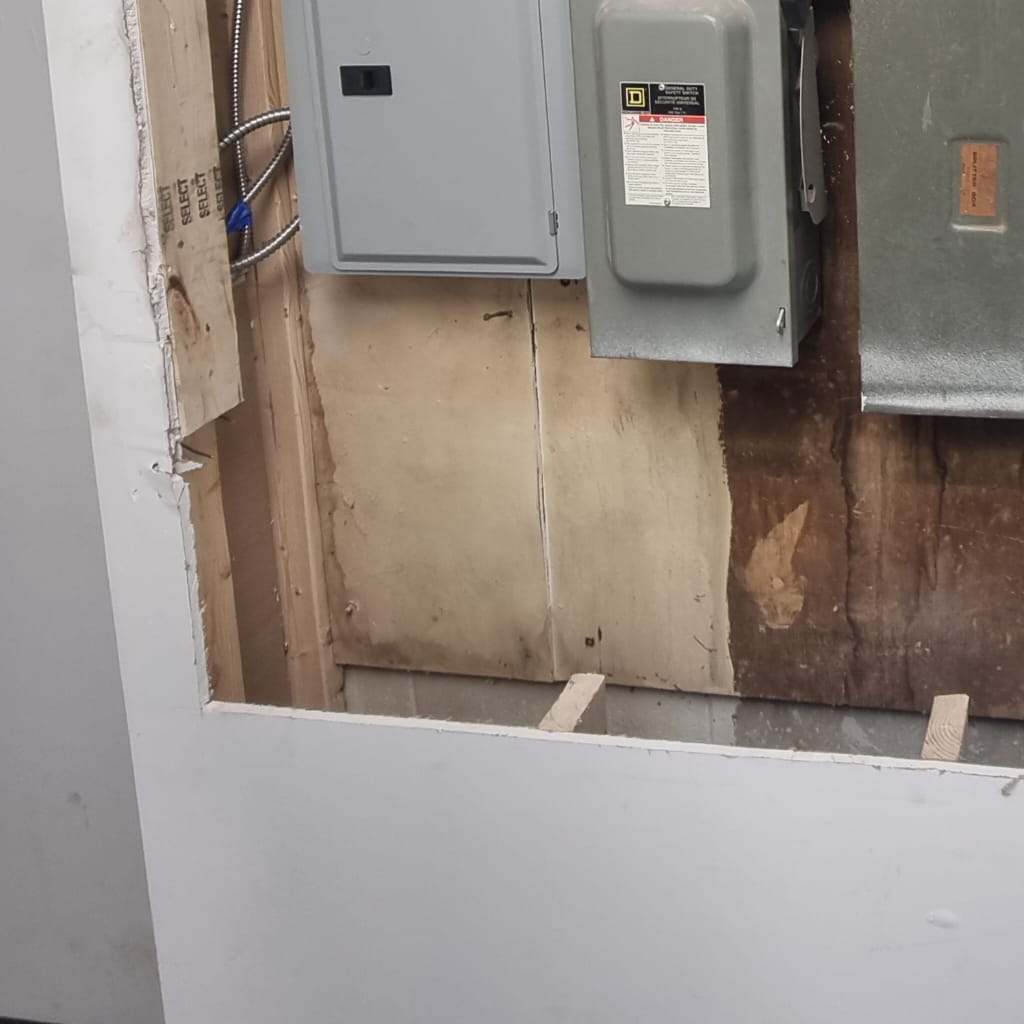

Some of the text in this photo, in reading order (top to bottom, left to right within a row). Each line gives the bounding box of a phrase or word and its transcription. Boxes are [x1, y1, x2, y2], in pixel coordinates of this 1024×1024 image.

[159, 185, 175, 234] SELECT
[177, 179, 192, 226] SELECT
[195, 172, 210, 218] SELECT
